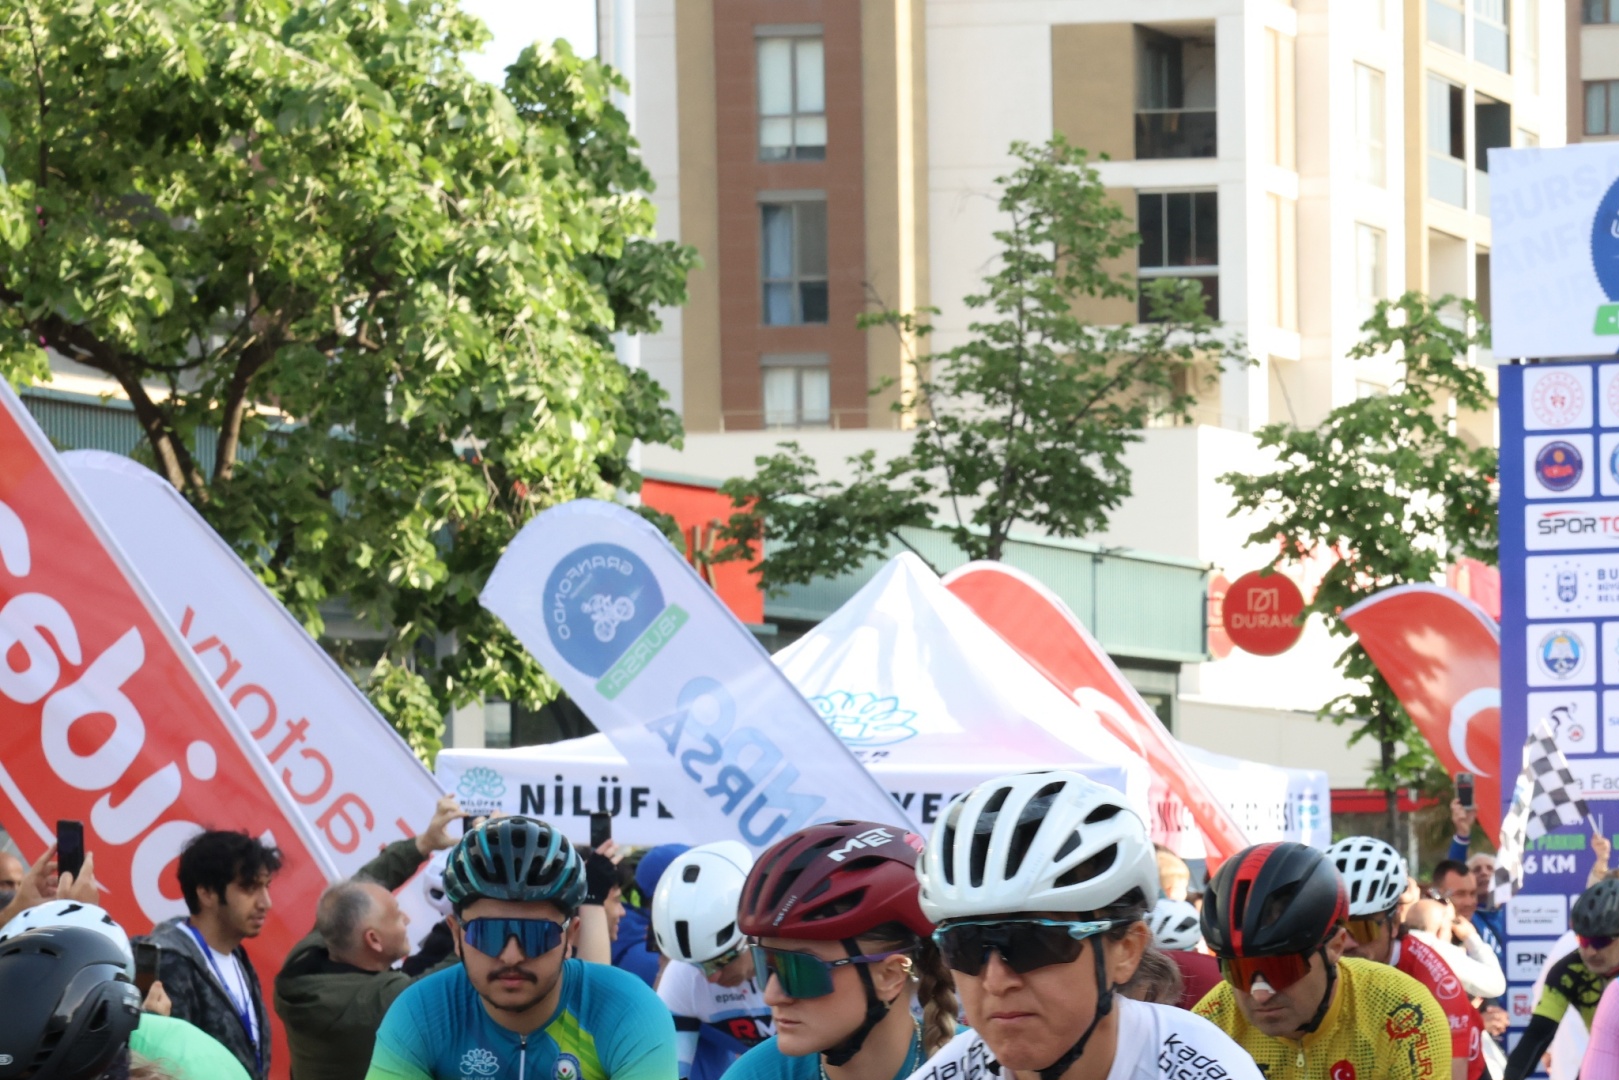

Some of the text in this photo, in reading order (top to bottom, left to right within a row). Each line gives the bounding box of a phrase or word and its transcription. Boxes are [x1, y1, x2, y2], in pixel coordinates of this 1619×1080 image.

[520, 774, 675, 819] NİLÜF
[827, 828, 895, 862] MET
[1542, 854, 1576, 874] KM
